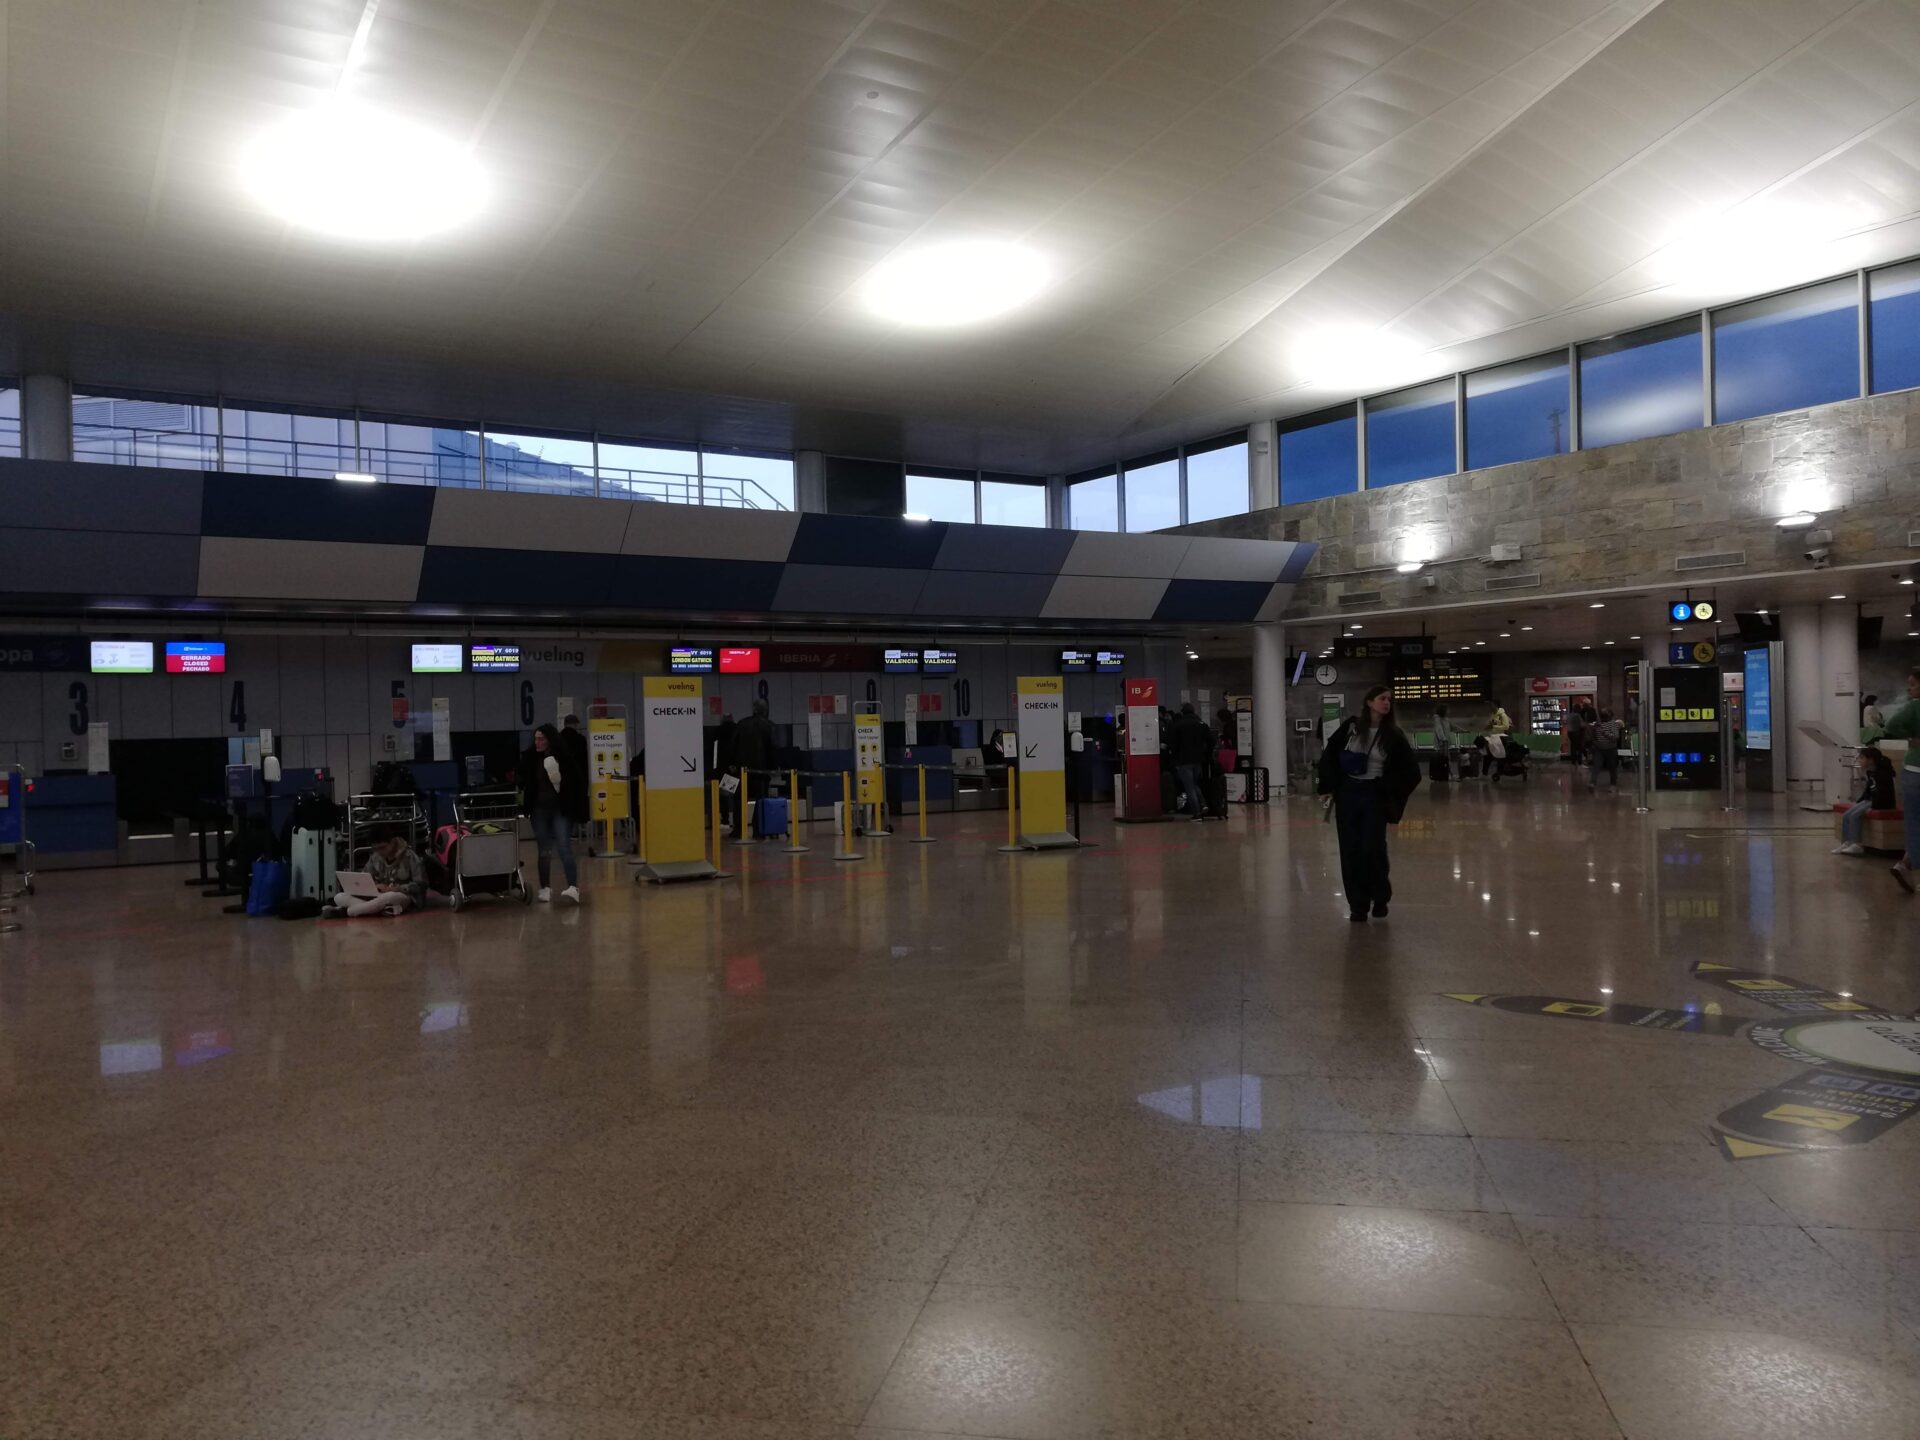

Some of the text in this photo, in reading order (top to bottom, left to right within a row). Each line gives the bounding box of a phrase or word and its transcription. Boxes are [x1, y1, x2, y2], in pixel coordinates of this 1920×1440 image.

[522, 645, 586, 668] vueling
[779, 654, 820, 663] IBERIA
[667, 682, 695, 691] vueling
[1036, 681, 1057, 690] vueling
[1131, 687, 1141, 695] IB
[521, 679, 535, 725] 6
[953, 678, 970, 717] 10
[69, 681, 88, 735] 3
[230, 681, 246, 732] 4
[1024, 702, 1058, 710] CHECK-IN
[653, 707, 696, 716] CHECK-IN
